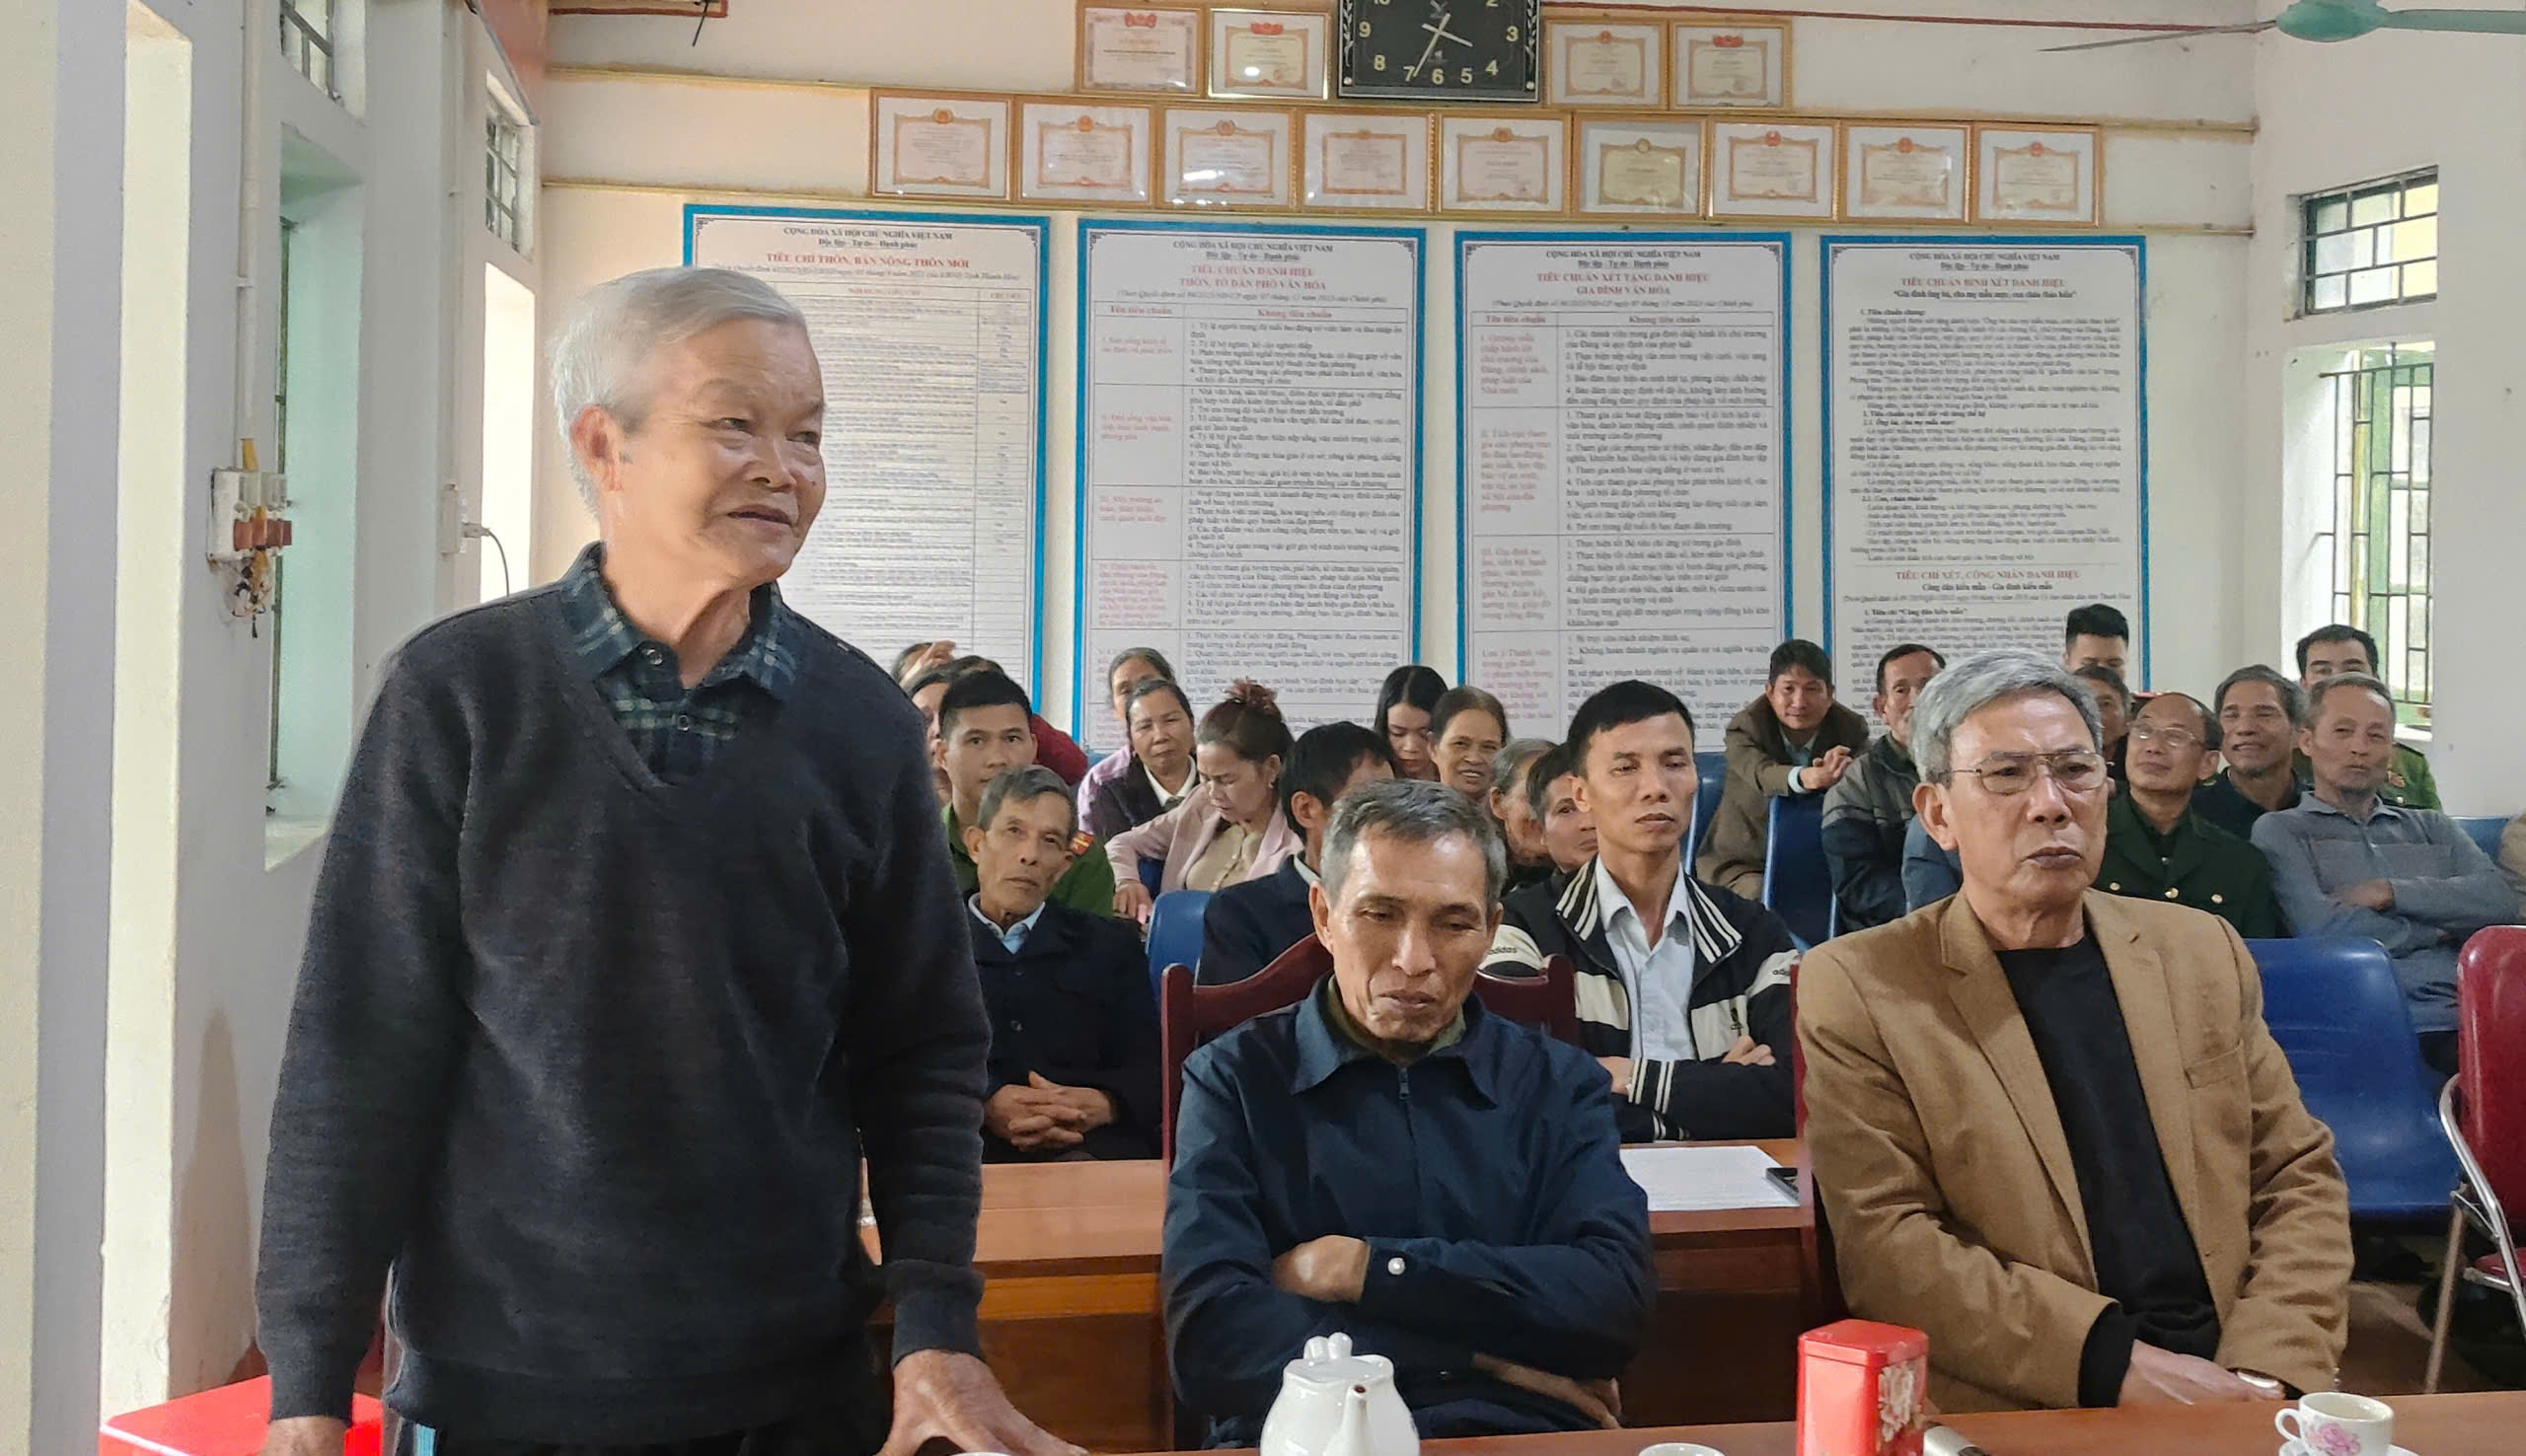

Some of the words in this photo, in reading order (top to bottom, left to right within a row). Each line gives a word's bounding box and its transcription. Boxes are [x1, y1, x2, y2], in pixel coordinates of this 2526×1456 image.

[1359, 21, 1372, 37] 9
[1506, 26, 1519, 41] 3
[1374, 54, 1385, 71] 8
[1485, 59, 1498, 76] 4
[1403, 66, 1415, 82] 7
[1432, 68, 1445, 85] 6
[1460, 67, 1473, 84] 5
